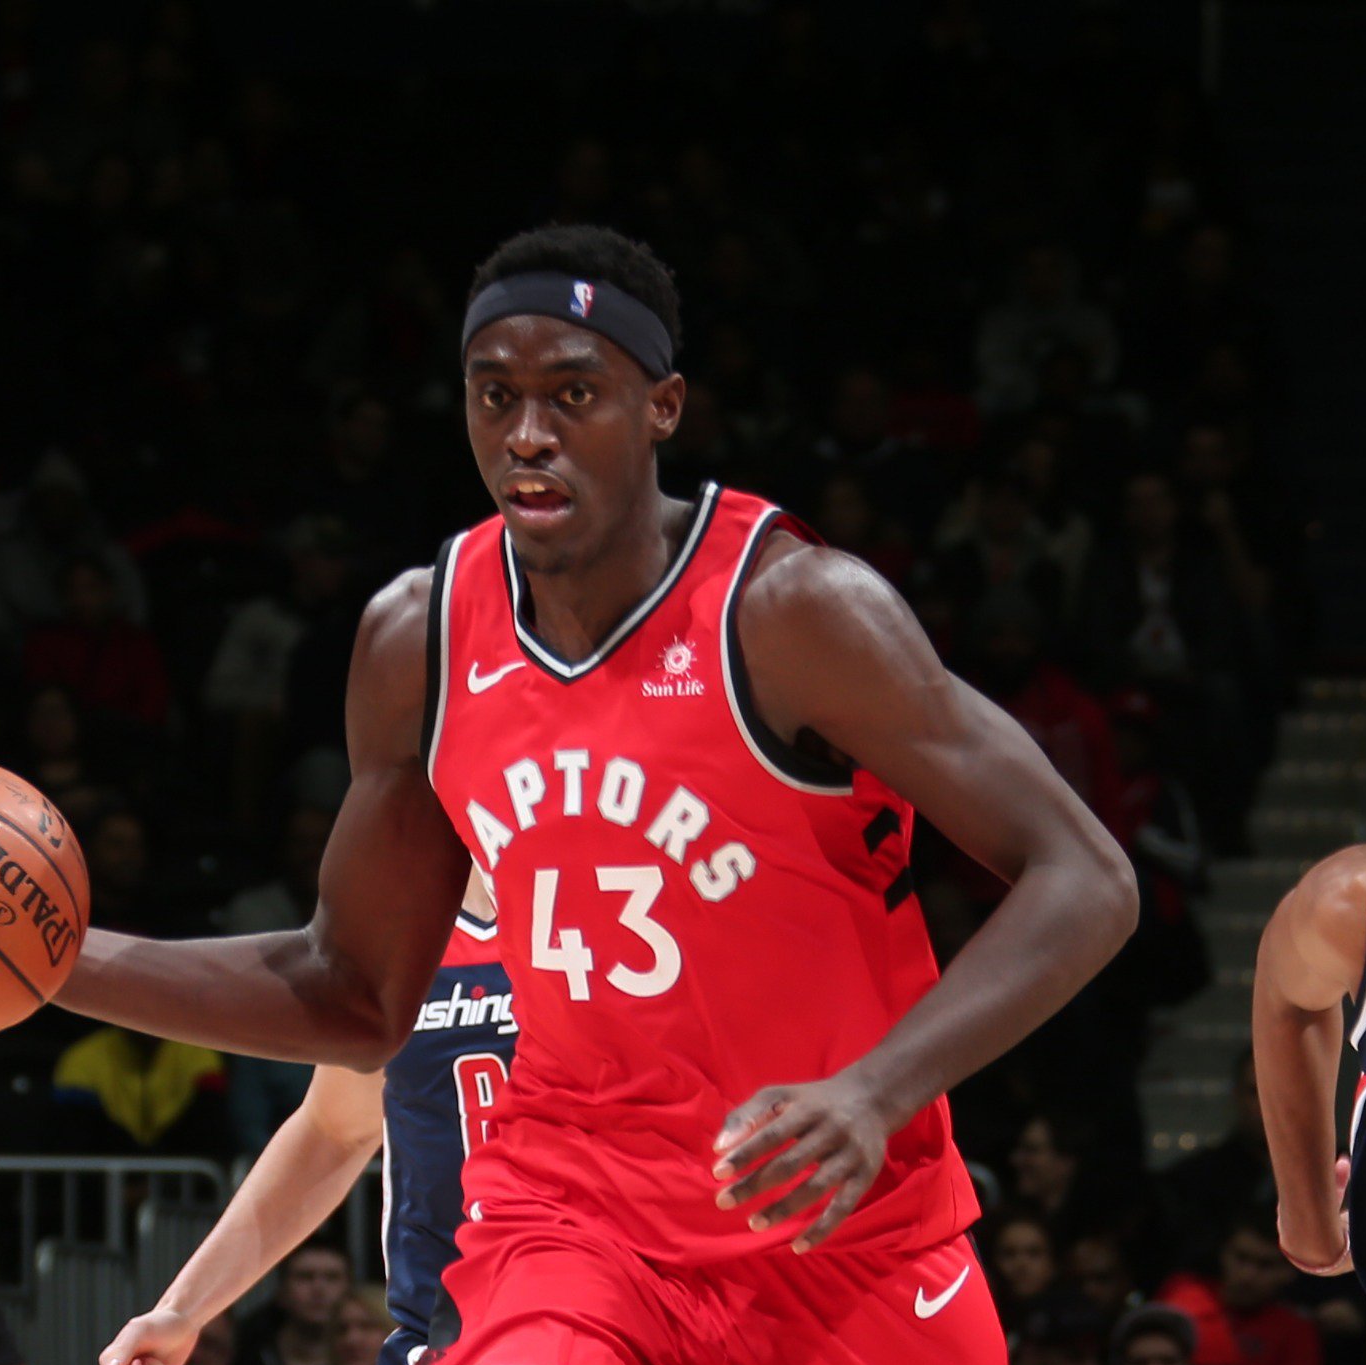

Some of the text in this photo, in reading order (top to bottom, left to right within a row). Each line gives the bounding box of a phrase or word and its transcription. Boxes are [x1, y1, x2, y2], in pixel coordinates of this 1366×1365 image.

[641, 679, 705, 698] Sun Life
[466, 748, 757, 903] APTORS
[531, 865, 682, 1001] 43
